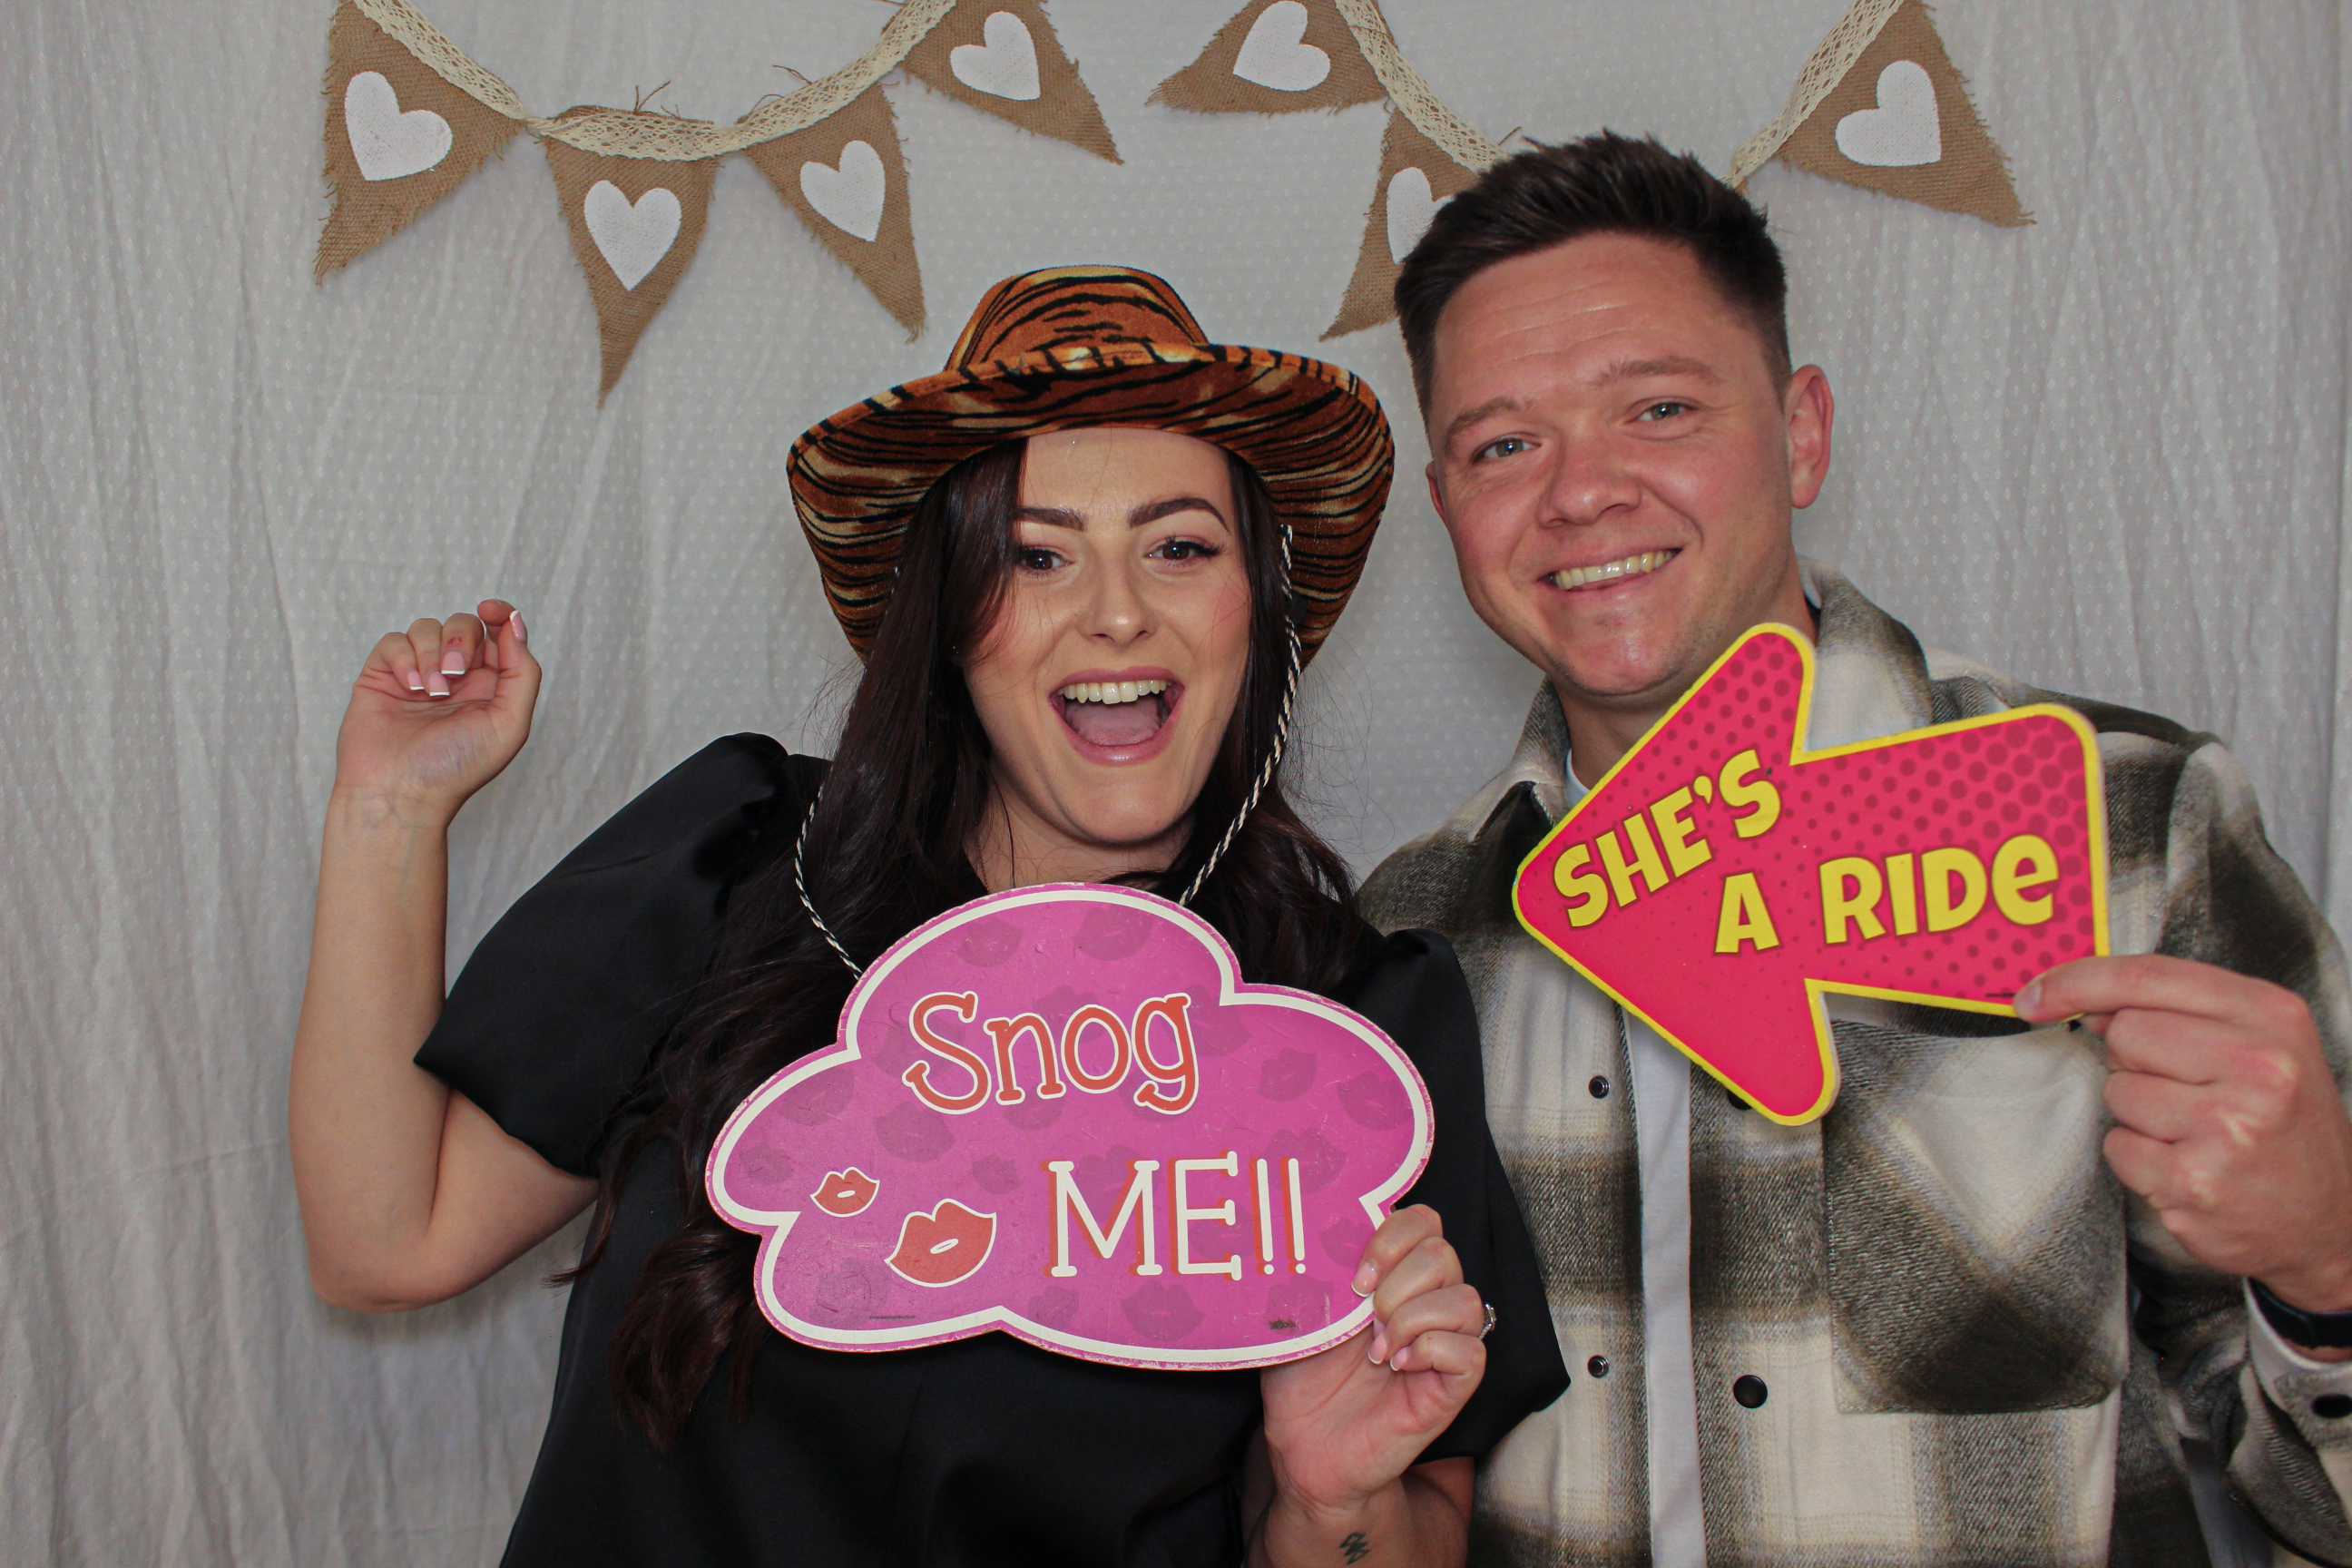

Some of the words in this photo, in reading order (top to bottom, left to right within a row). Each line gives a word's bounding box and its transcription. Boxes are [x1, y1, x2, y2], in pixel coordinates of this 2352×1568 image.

[1553, 749, 1782, 928] SHE'S
[1714, 872, 1780, 954] A
[902, 991, 1199, 1115] Snog
[1043, 1150, 1307, 1281] ME!!
